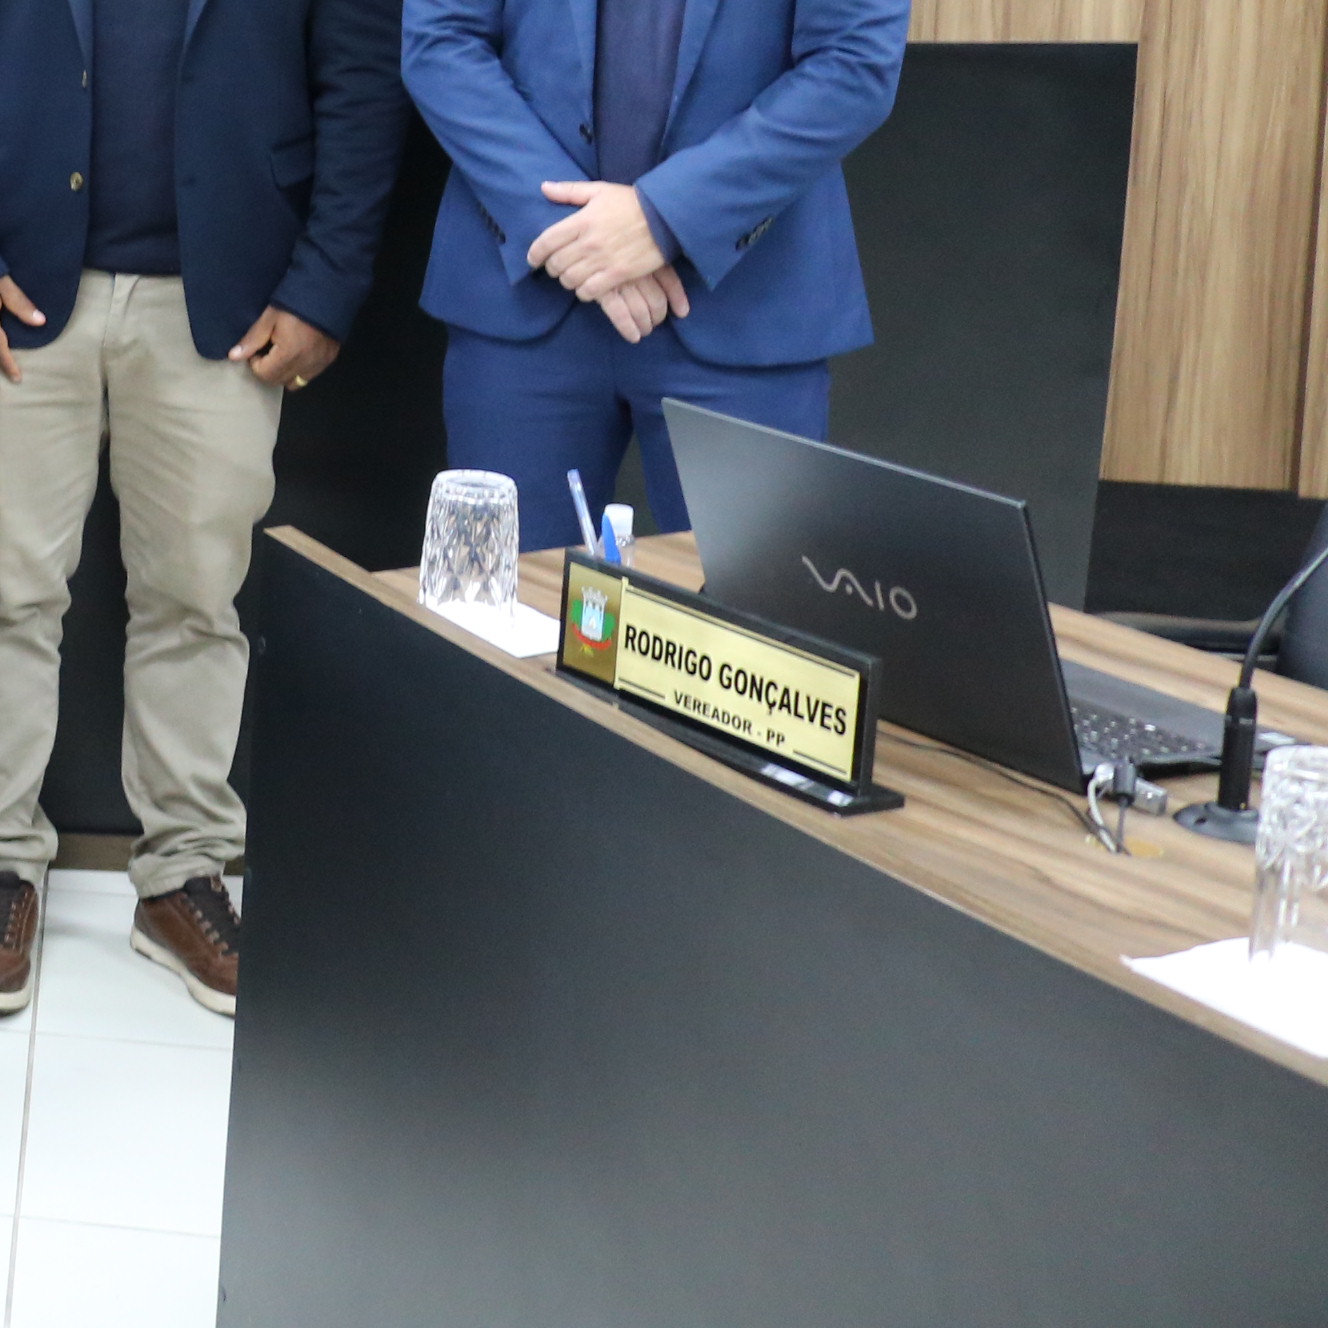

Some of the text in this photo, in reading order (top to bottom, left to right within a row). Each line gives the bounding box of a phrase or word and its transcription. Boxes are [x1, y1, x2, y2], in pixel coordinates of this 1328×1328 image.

[801, 555, 917, 620] VAIO
[624, 624, 847, 736] RODRIGO GONÇALVES
[674, 690, 753, 737] VEREADOR
[766, 729, 786, 747] PP
